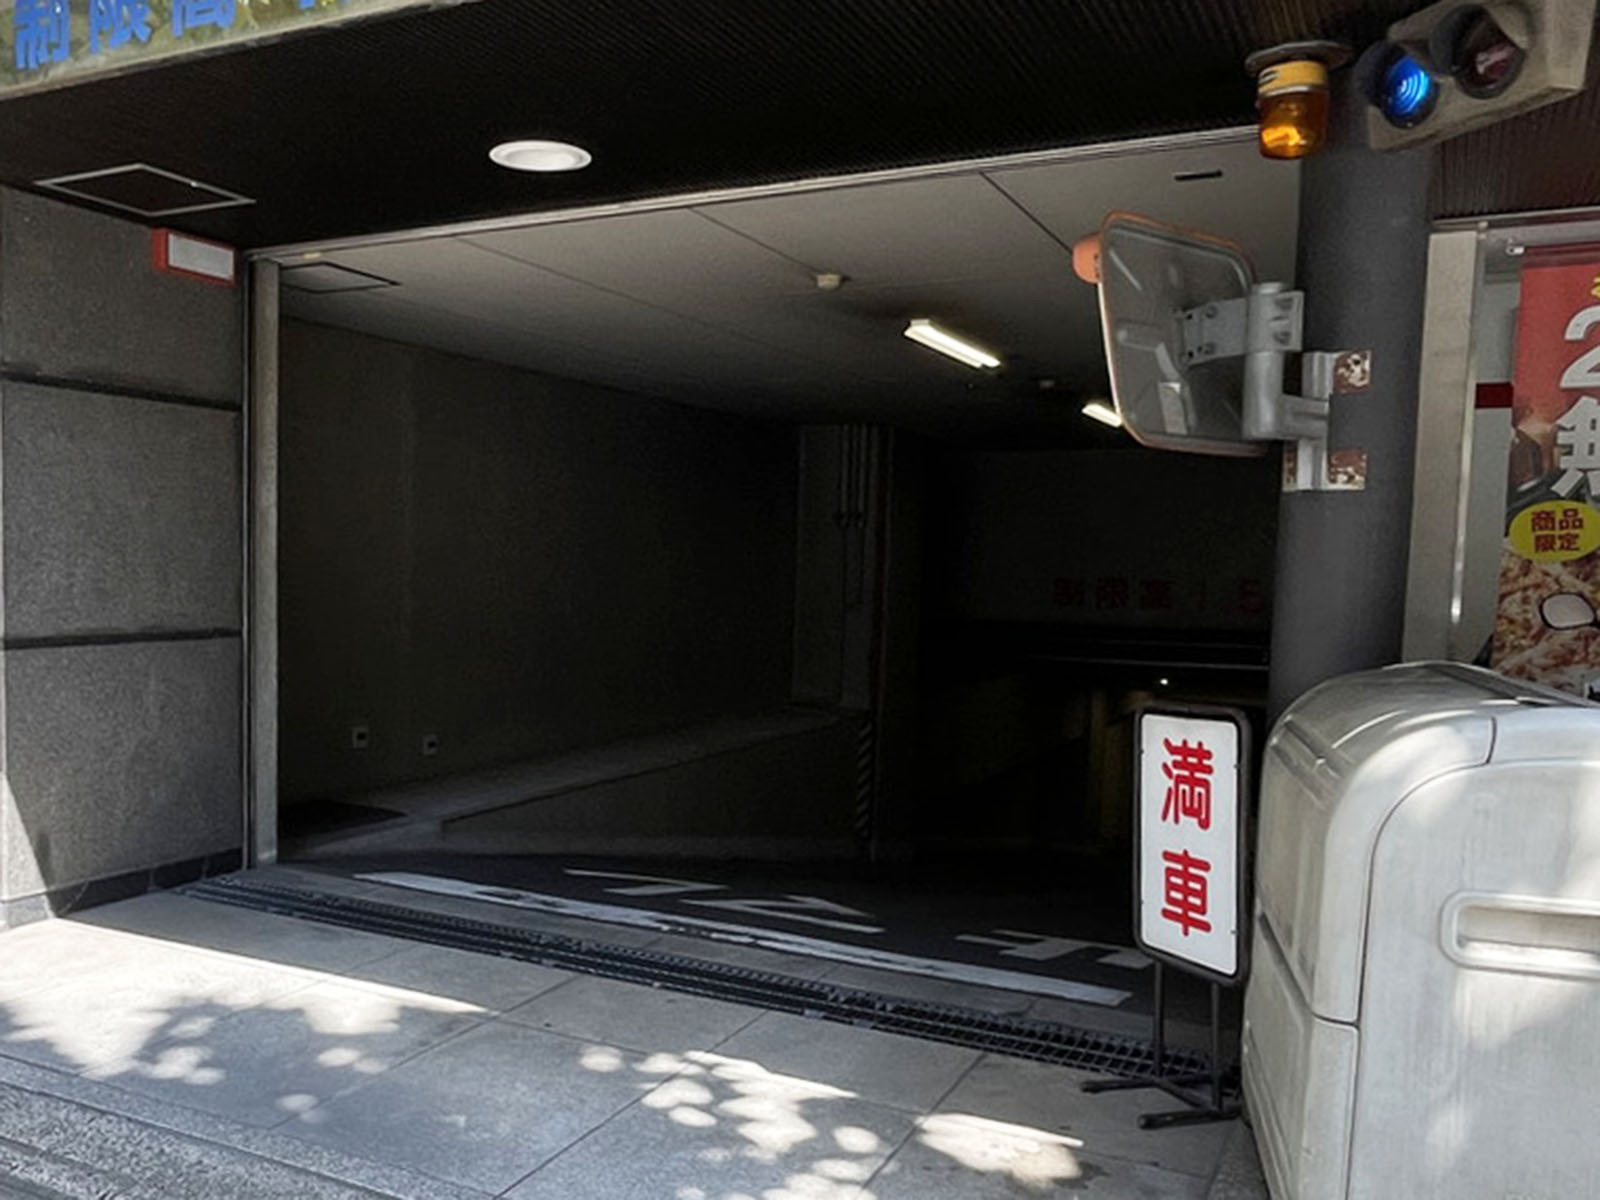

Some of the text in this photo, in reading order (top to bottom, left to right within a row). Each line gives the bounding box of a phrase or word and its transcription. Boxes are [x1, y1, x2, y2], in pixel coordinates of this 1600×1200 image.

[1531, 508, 1584, 532] 商品
[1534, 533, 1580, 553] 限定
[1162, 738, 1214, 937] 満車
